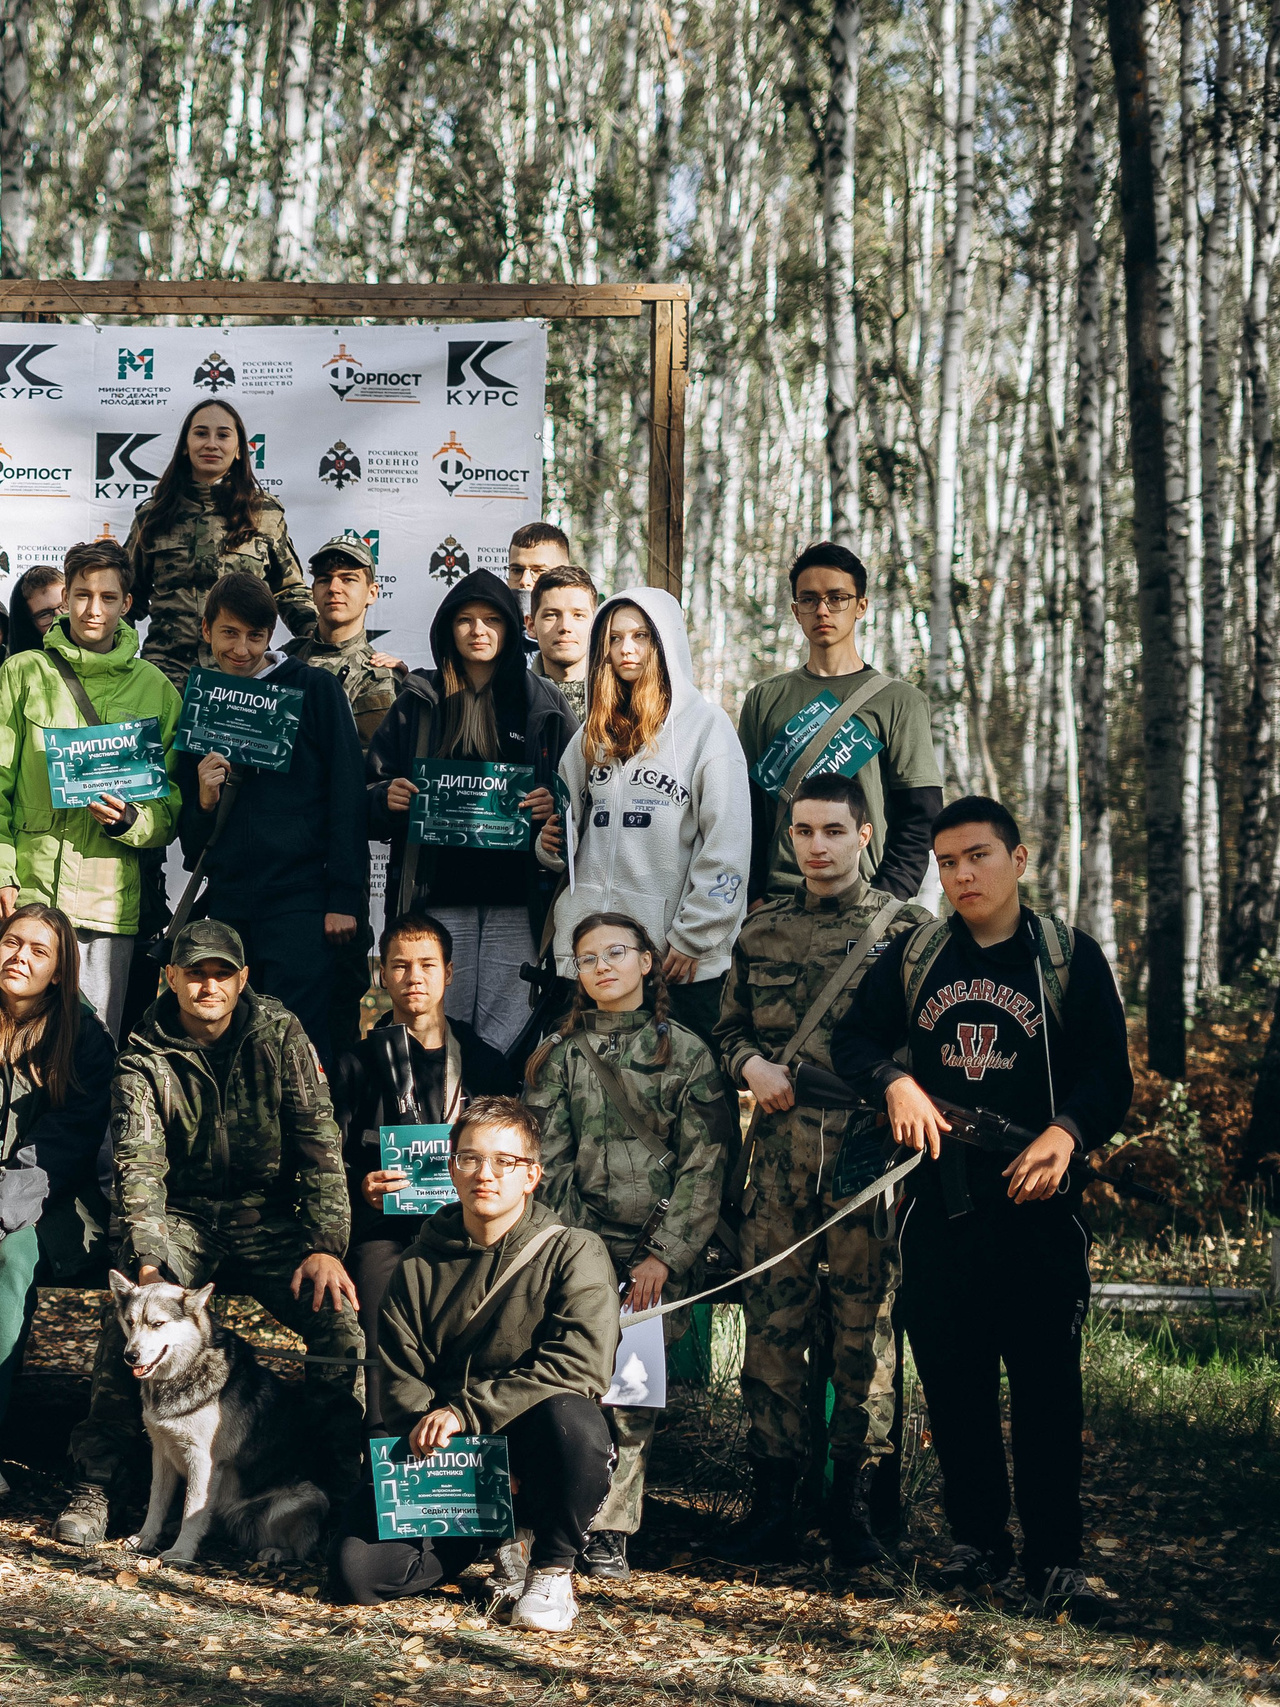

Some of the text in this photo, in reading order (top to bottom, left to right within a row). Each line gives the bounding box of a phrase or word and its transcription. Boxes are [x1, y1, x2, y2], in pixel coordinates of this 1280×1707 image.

[241, 380, 293, 388] ОБЩЕСТВО
[446, 390, 519, 406] КУРС
[367, 449, 418, 457] РОССИЙСКОЕ
[367, 458, 419, 466] ВОЕННО
[367, 476, 419, 484] ОБЩЕСТВО
[17, 544, 67, 552] РОССИЙСКОЕ
[477, 555, 509, 563] ВОЕН
[210, 686, 278, 711] ДИПЛОМ
[226, 703, 257, 715] участника
[70, 734, 137, 756] ДИПЛОМ
[88, 750, 120, 759] участника
[439, 774, 508, 791] ДИПЛОМ
[456, 789, 488, 797] участника
[707, 872, 743, 905] 23
[410, 1139, 451, 1157] ДИПЛ
[406, 1452, 483, 1471] ДИПЛОМ
[426, 1469, 464, 1478] участника
[421, 1507, 481, 1516] Седых Никите
